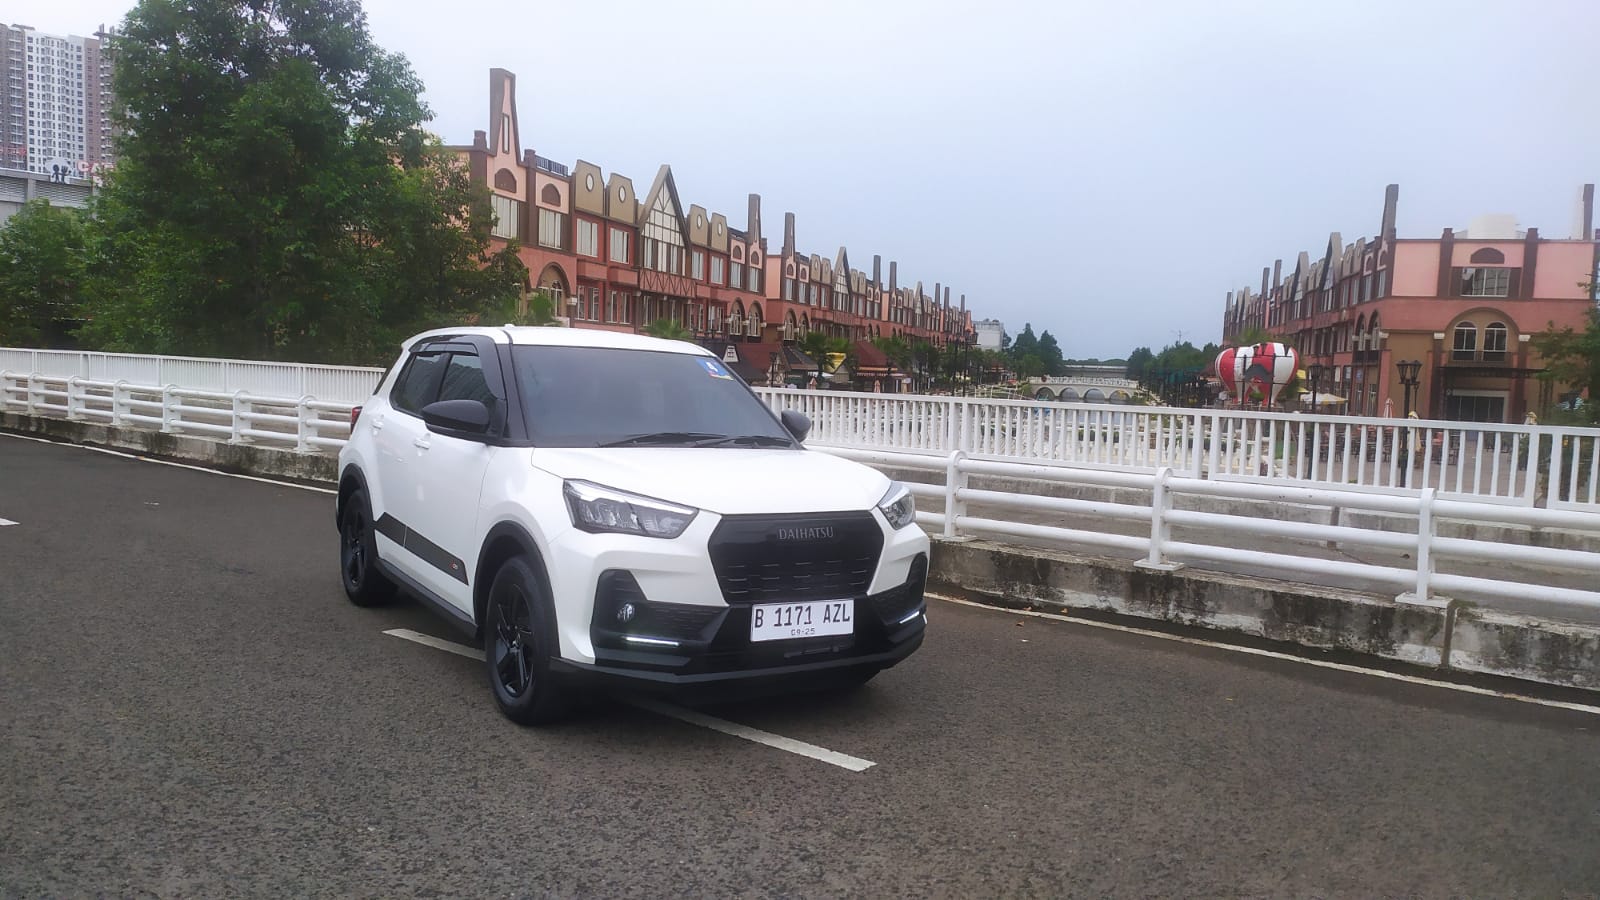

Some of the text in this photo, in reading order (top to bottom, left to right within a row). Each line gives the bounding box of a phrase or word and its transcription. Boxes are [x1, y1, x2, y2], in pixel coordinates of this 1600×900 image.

[778, 526, 834, 540] DAIHATSU
[754, 603, 850, 628] B 1171 AZL
